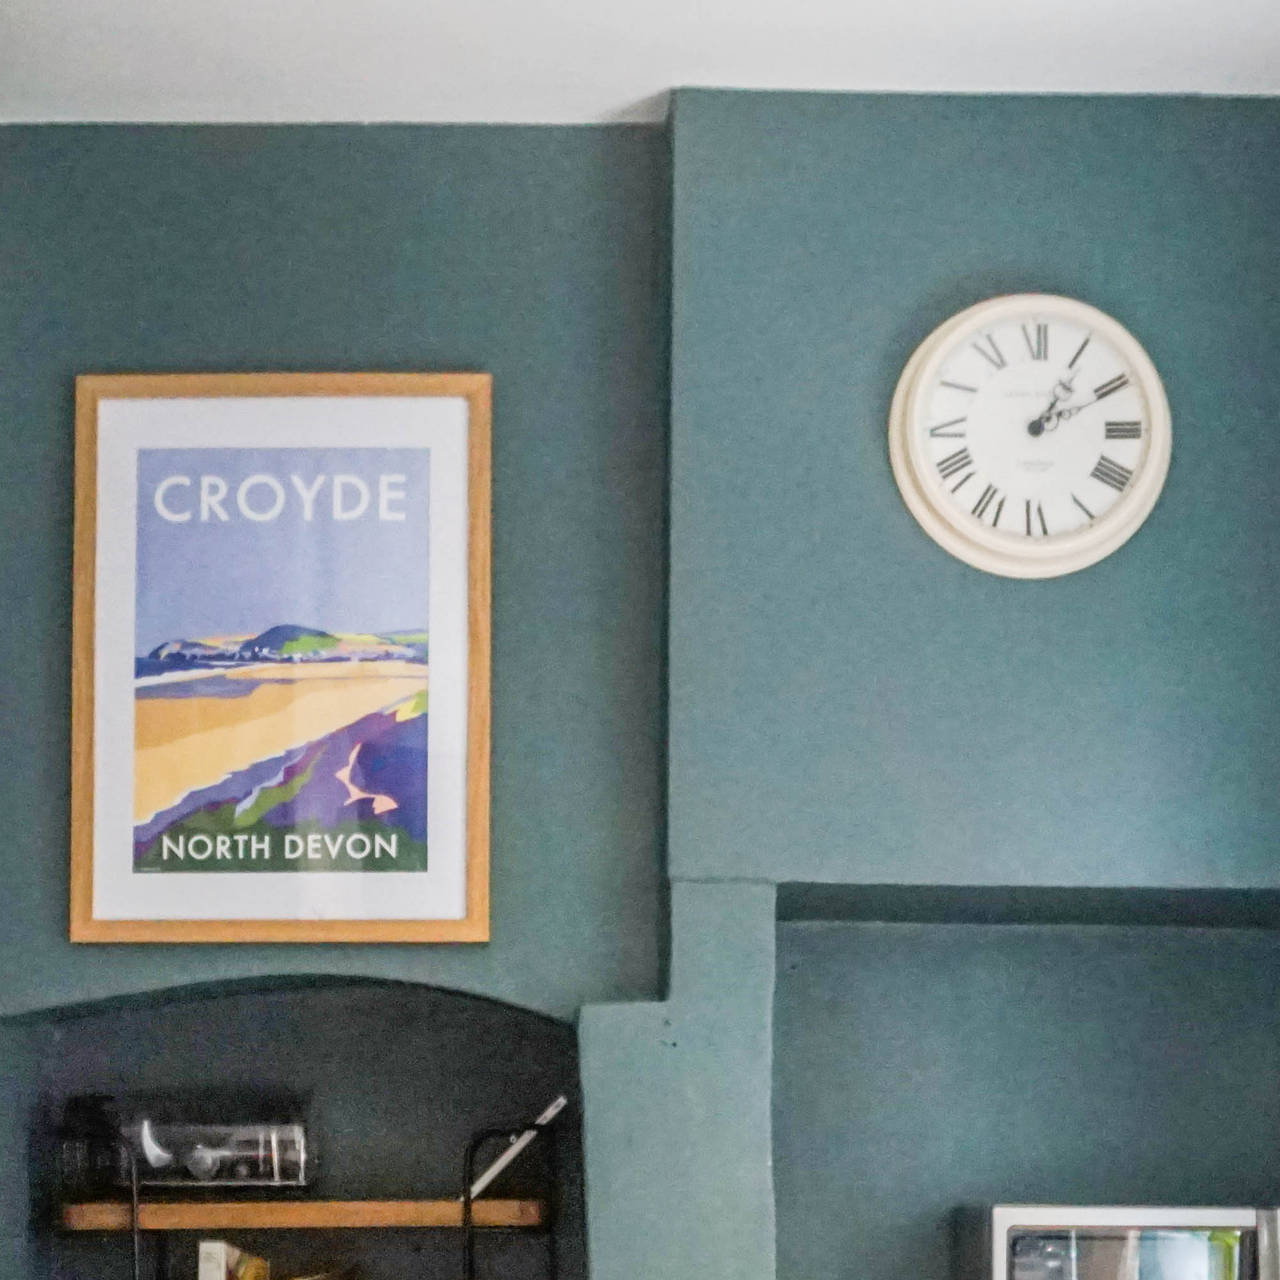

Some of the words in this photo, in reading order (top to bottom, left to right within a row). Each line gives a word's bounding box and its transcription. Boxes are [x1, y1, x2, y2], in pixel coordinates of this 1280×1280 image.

[154, 474, 407, 522] CROYDE
[162, 834, 269, 860] NORTH
[284, 833, 398, 859] DEVON
